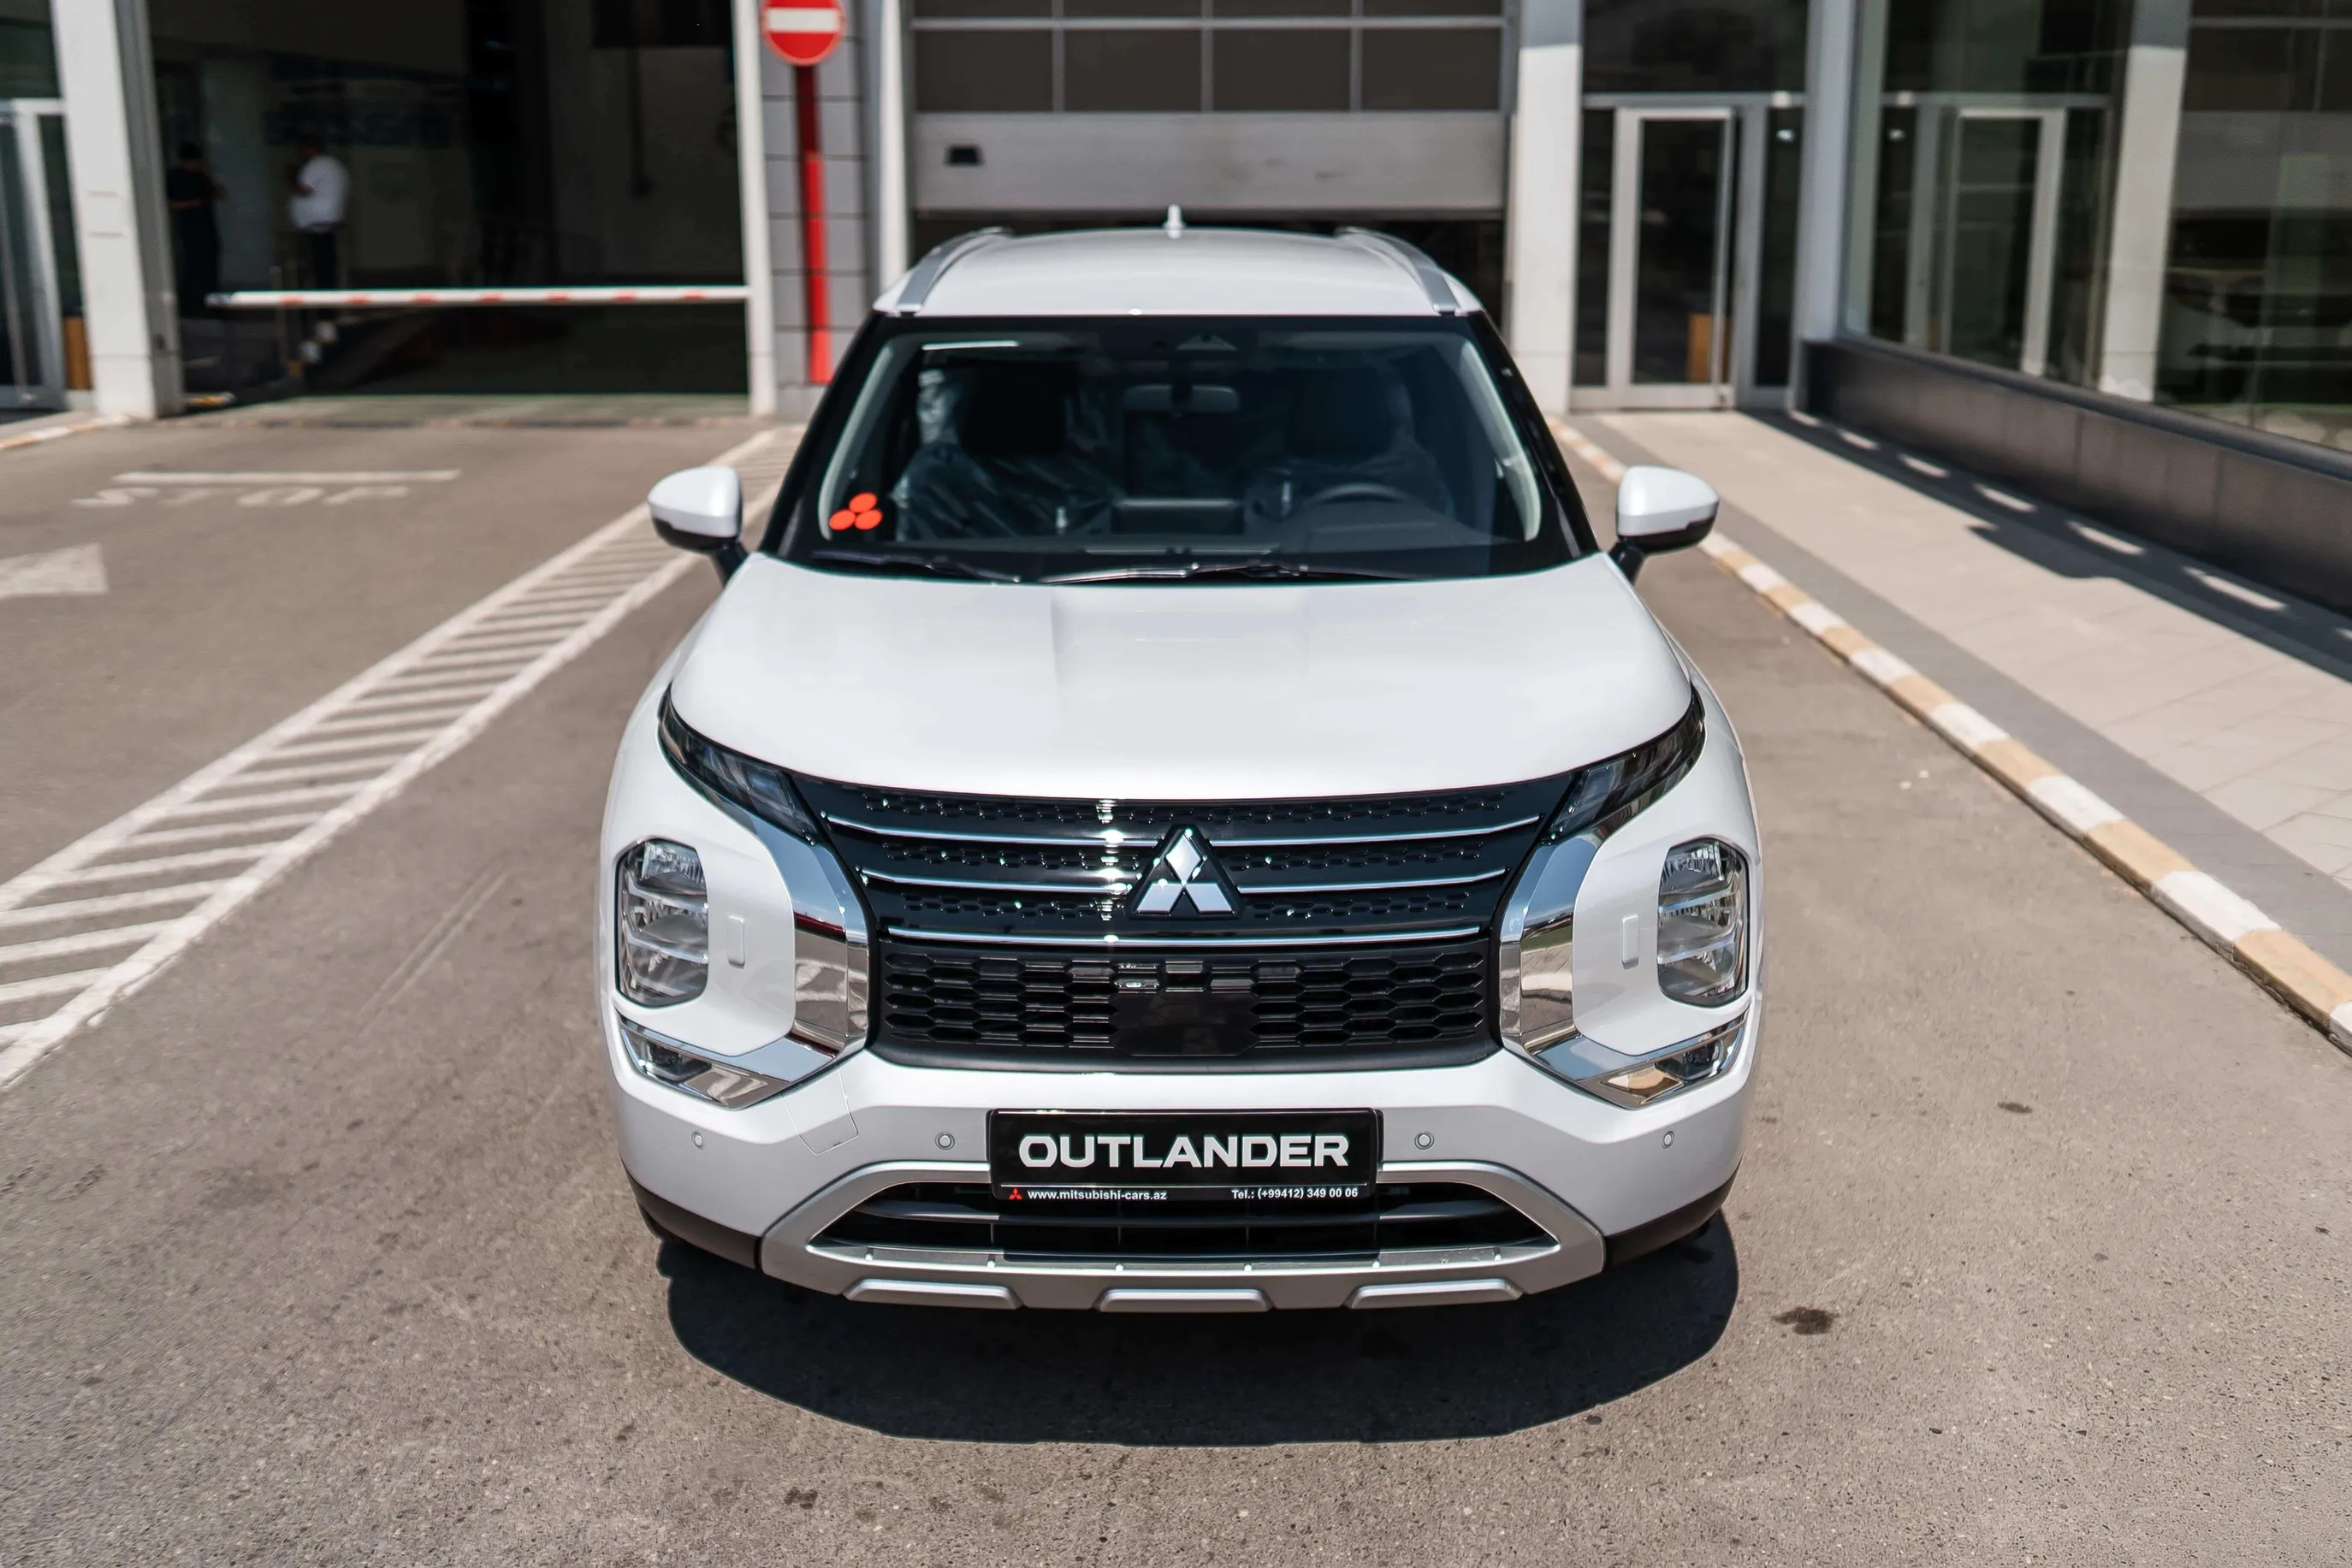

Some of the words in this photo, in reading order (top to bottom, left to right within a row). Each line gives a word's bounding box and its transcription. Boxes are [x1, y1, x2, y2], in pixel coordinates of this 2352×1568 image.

[1018, 1135, 1349, 1168] OUTLANDER
[1027, 1188, 1168, 1201] www.mitsubishi-cars.az
[1231, 1189, 1255, 1199] Tel.:
[1257, 1187, 1305, 1200] (+99412)
[1306, 1187, 1327, 1198] 349
[1329, 1187, 1342, 1198] 00
[1345, 1187, 1359, 1198] 06
